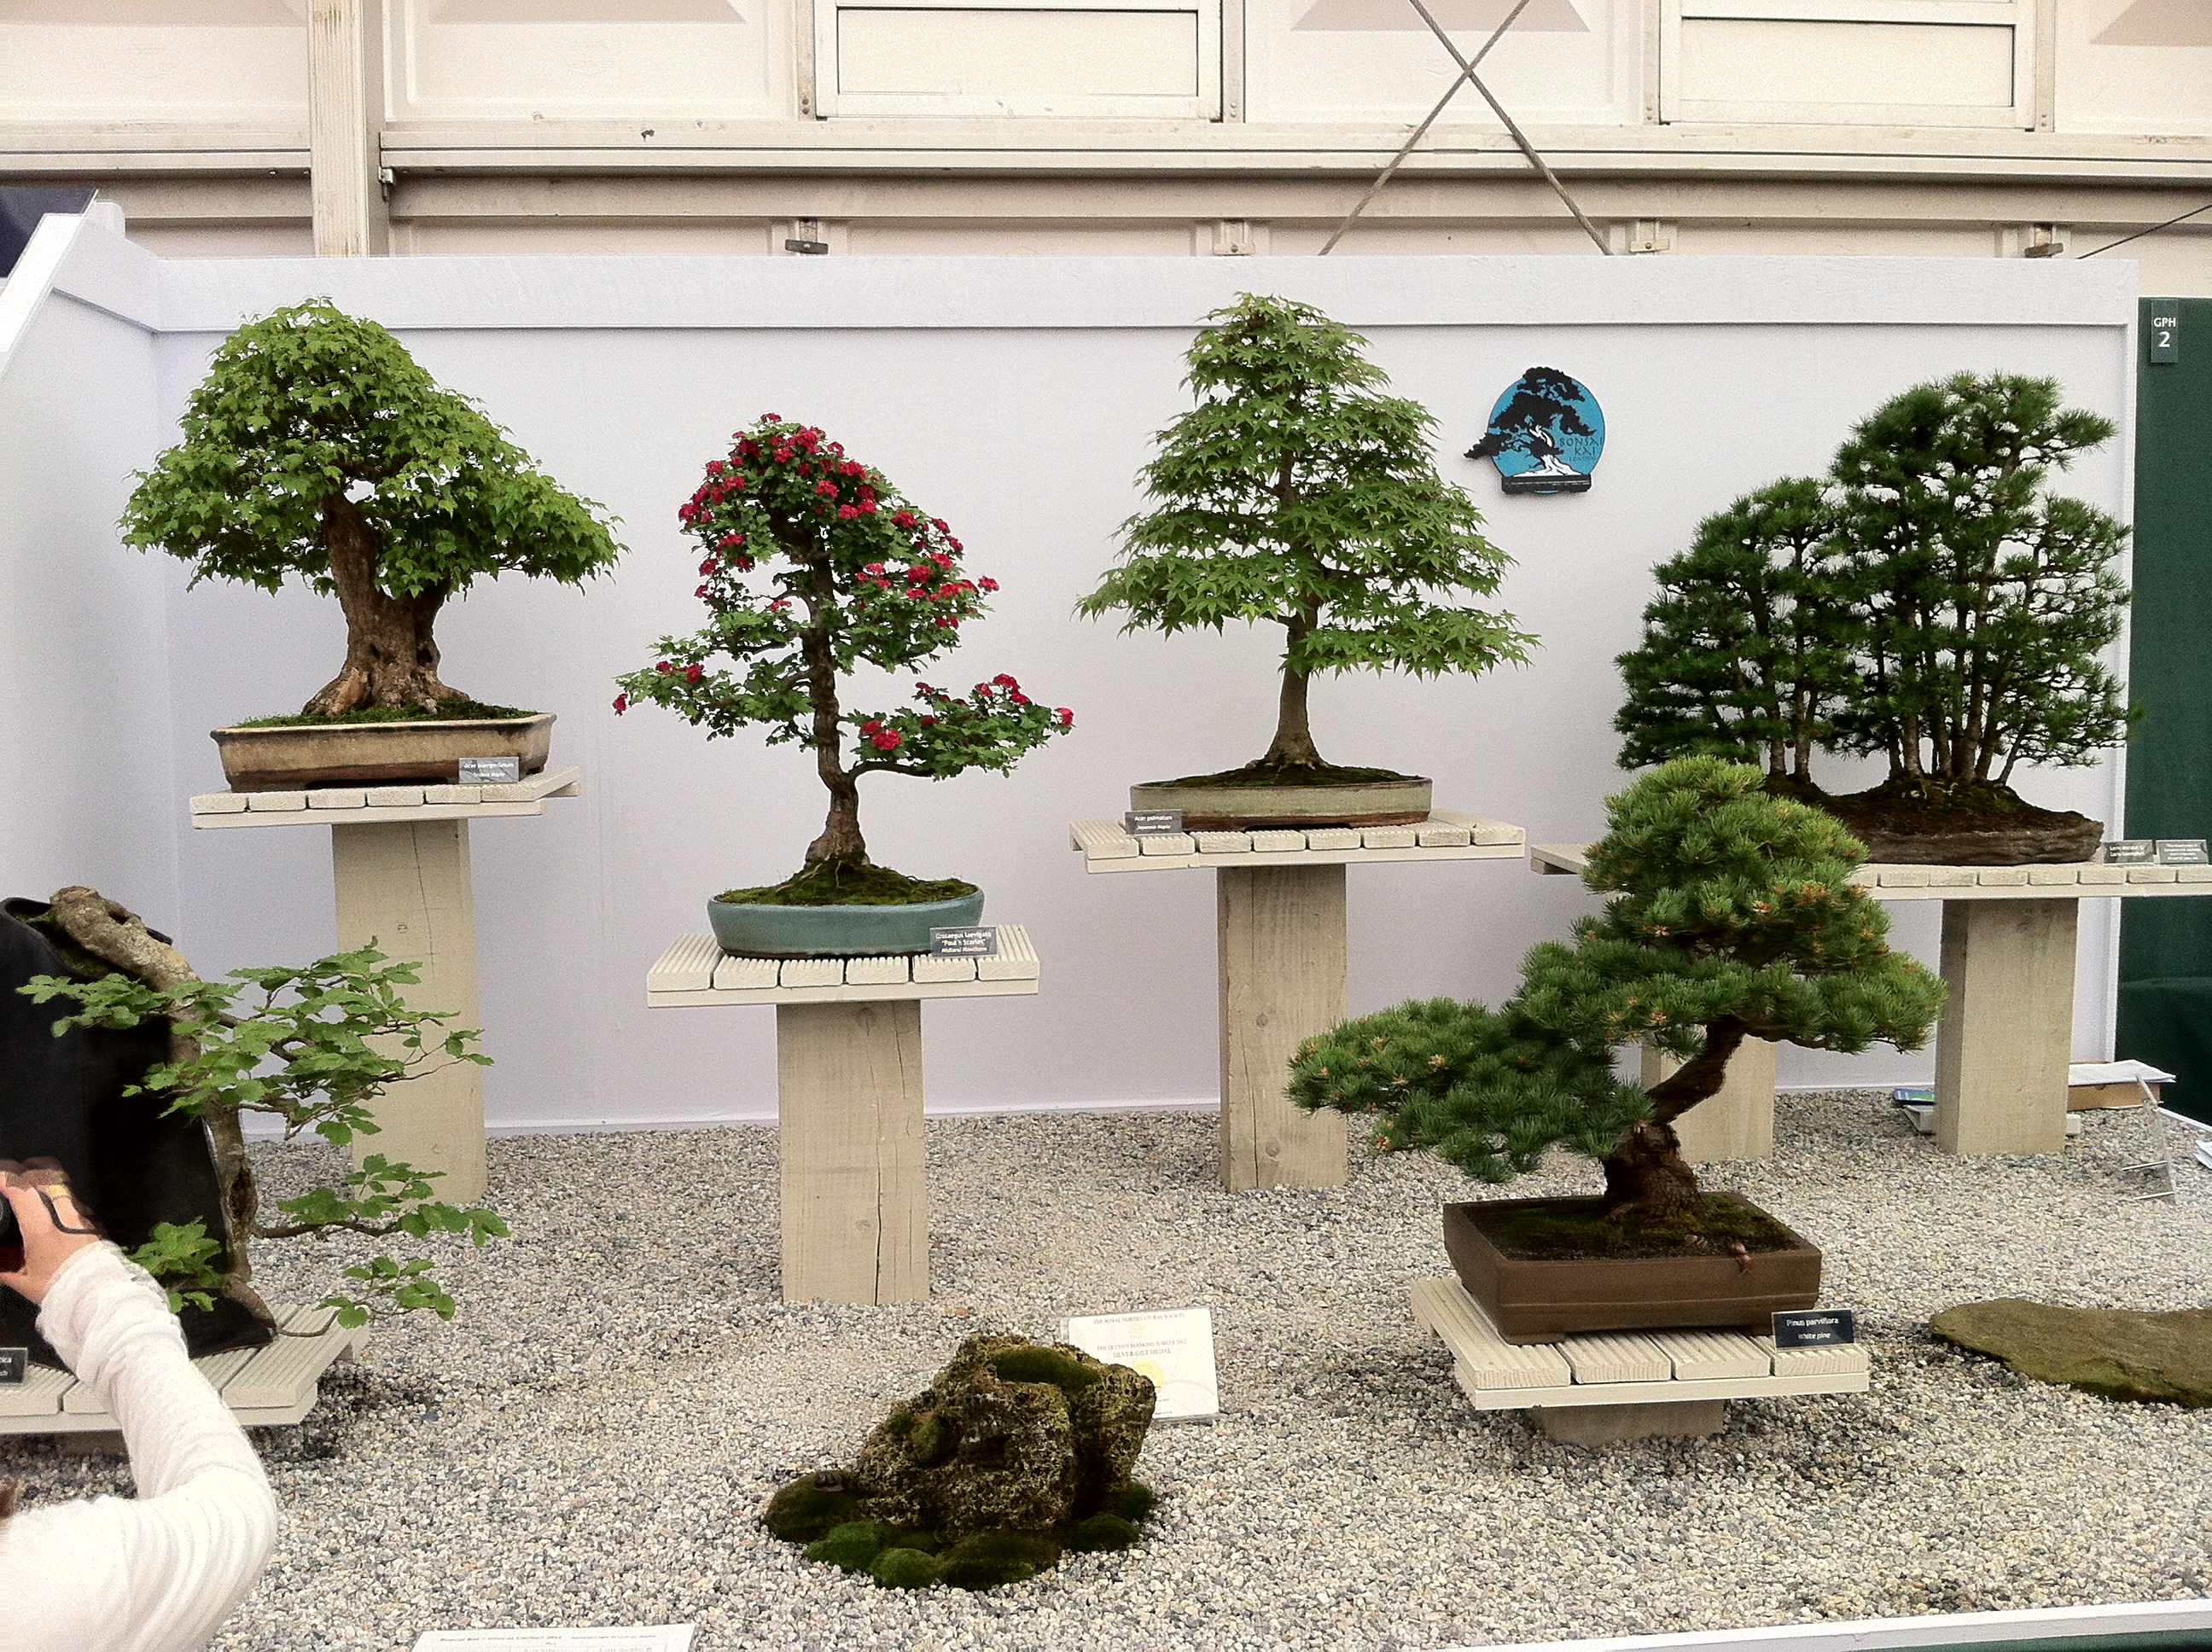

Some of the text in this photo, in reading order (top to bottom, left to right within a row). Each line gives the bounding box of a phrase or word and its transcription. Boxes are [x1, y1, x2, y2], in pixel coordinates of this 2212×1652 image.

[2153, 317, 2176, 328] GPH
[2158, 331, 2170, 348] 2
[1559, 436, 1603, 447] BONSAI
[1575, 446, 1595, 456] KAI
[1806, 1318, 1839, 1327] parviflora
